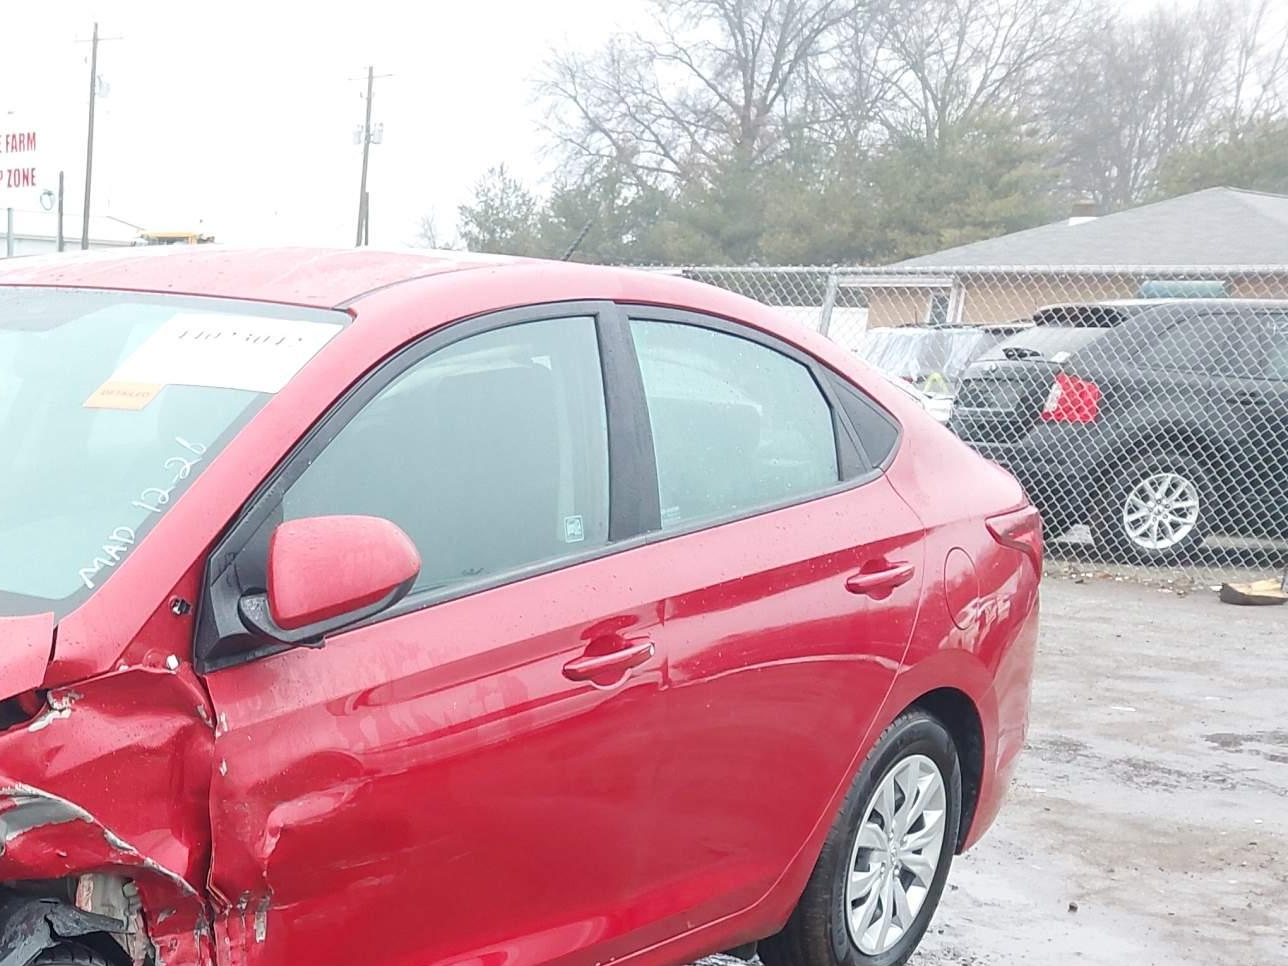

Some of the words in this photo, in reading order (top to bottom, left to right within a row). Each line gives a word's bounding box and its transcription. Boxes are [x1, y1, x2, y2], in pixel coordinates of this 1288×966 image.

[6, 131, 36, 153] FARM
[7, 167, 36, 188] ZONE
[78, 526, 135, 589] MAD
